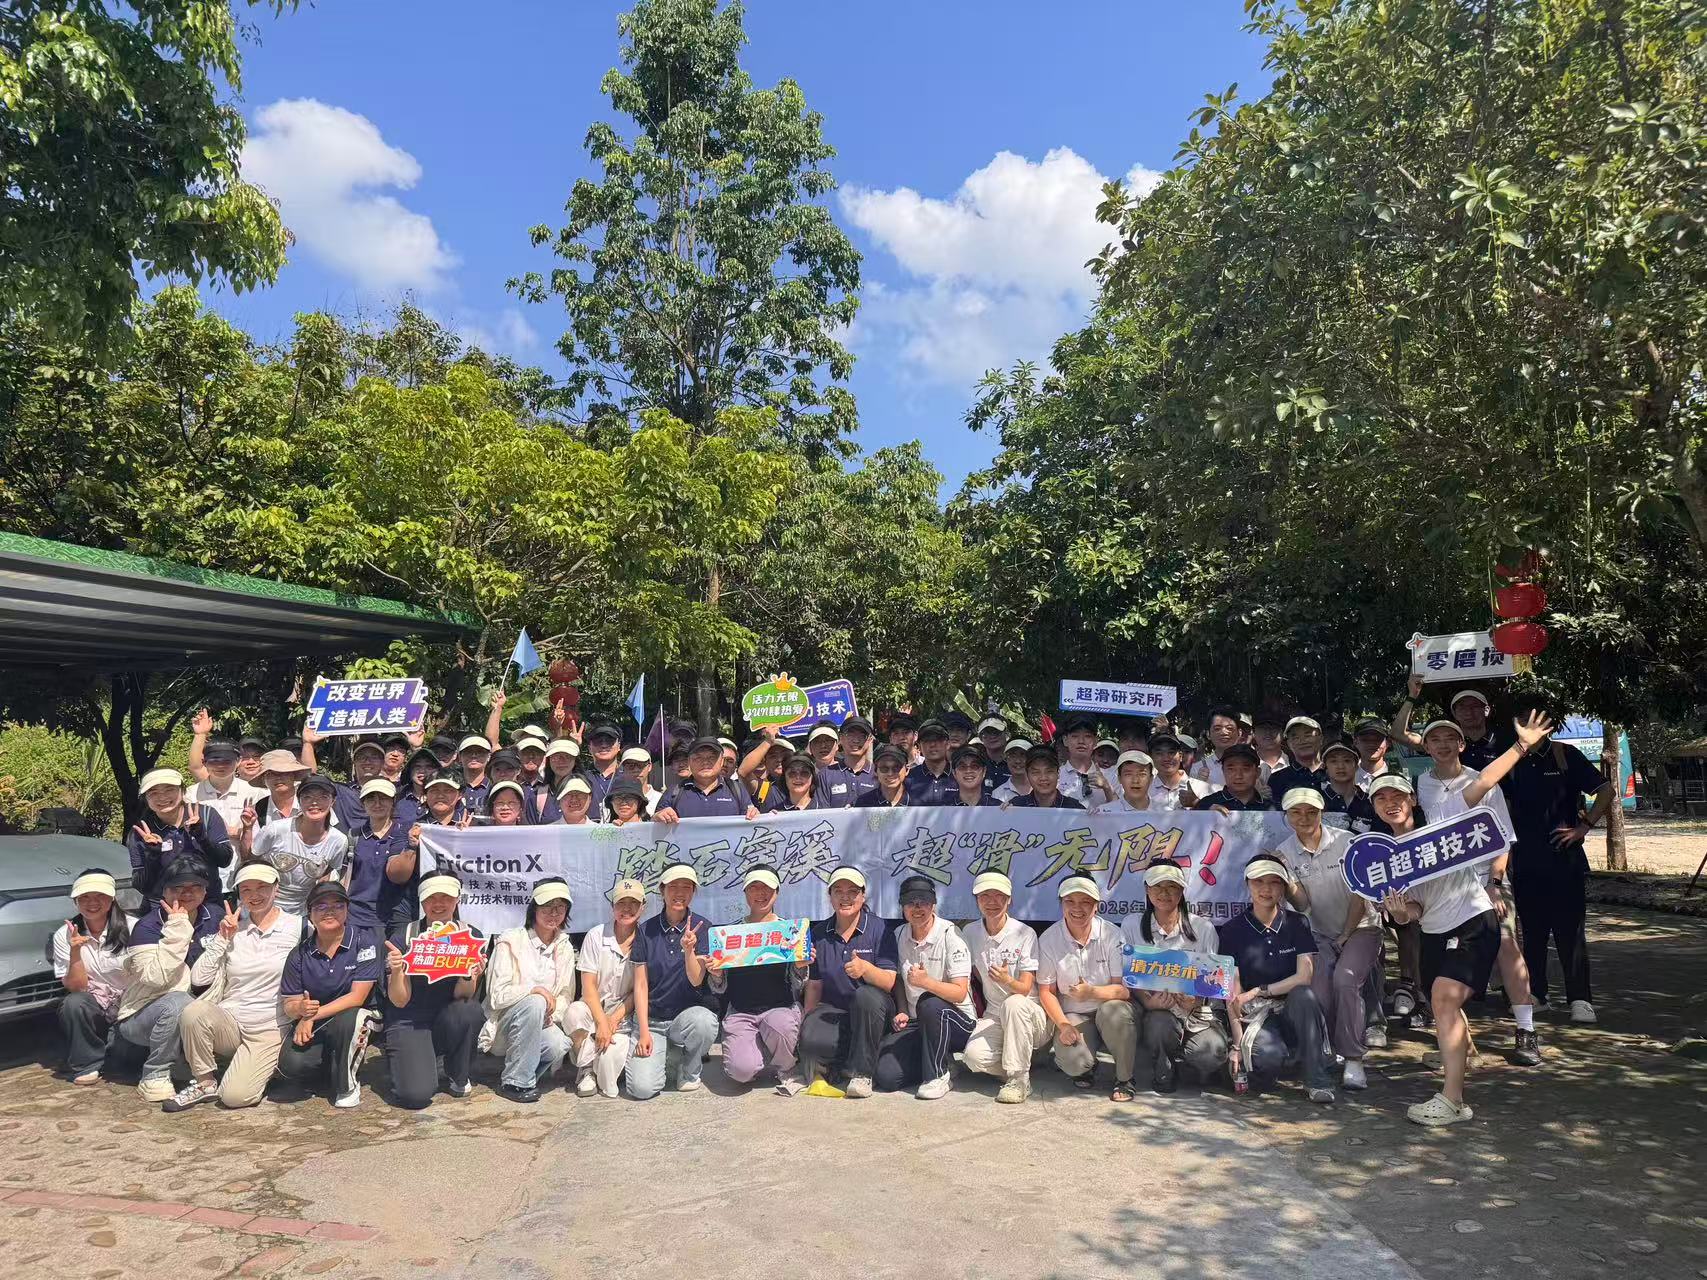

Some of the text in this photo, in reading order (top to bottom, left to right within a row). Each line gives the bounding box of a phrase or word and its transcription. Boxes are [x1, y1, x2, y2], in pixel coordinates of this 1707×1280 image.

[1427, 647, 1505, 671] 零磨损
[327, 683, 406, 702] 改变世界
[752, 691, 799, 705] 活力无限
[1076, 686, 1163, 708] 超滑研究所
[327, 706, 407, 728] 造福人类
[436, 853, 544, 874] Friction X
[1366, 822, 1492, 888] 自超滑技术
[460, 880, 540, 892] 技术研究
[413, 943, 469, 955] 给生活加满
[725, 931, 784, 950] 自超滑
[1130, 958, 1198, 980] 清力技术
